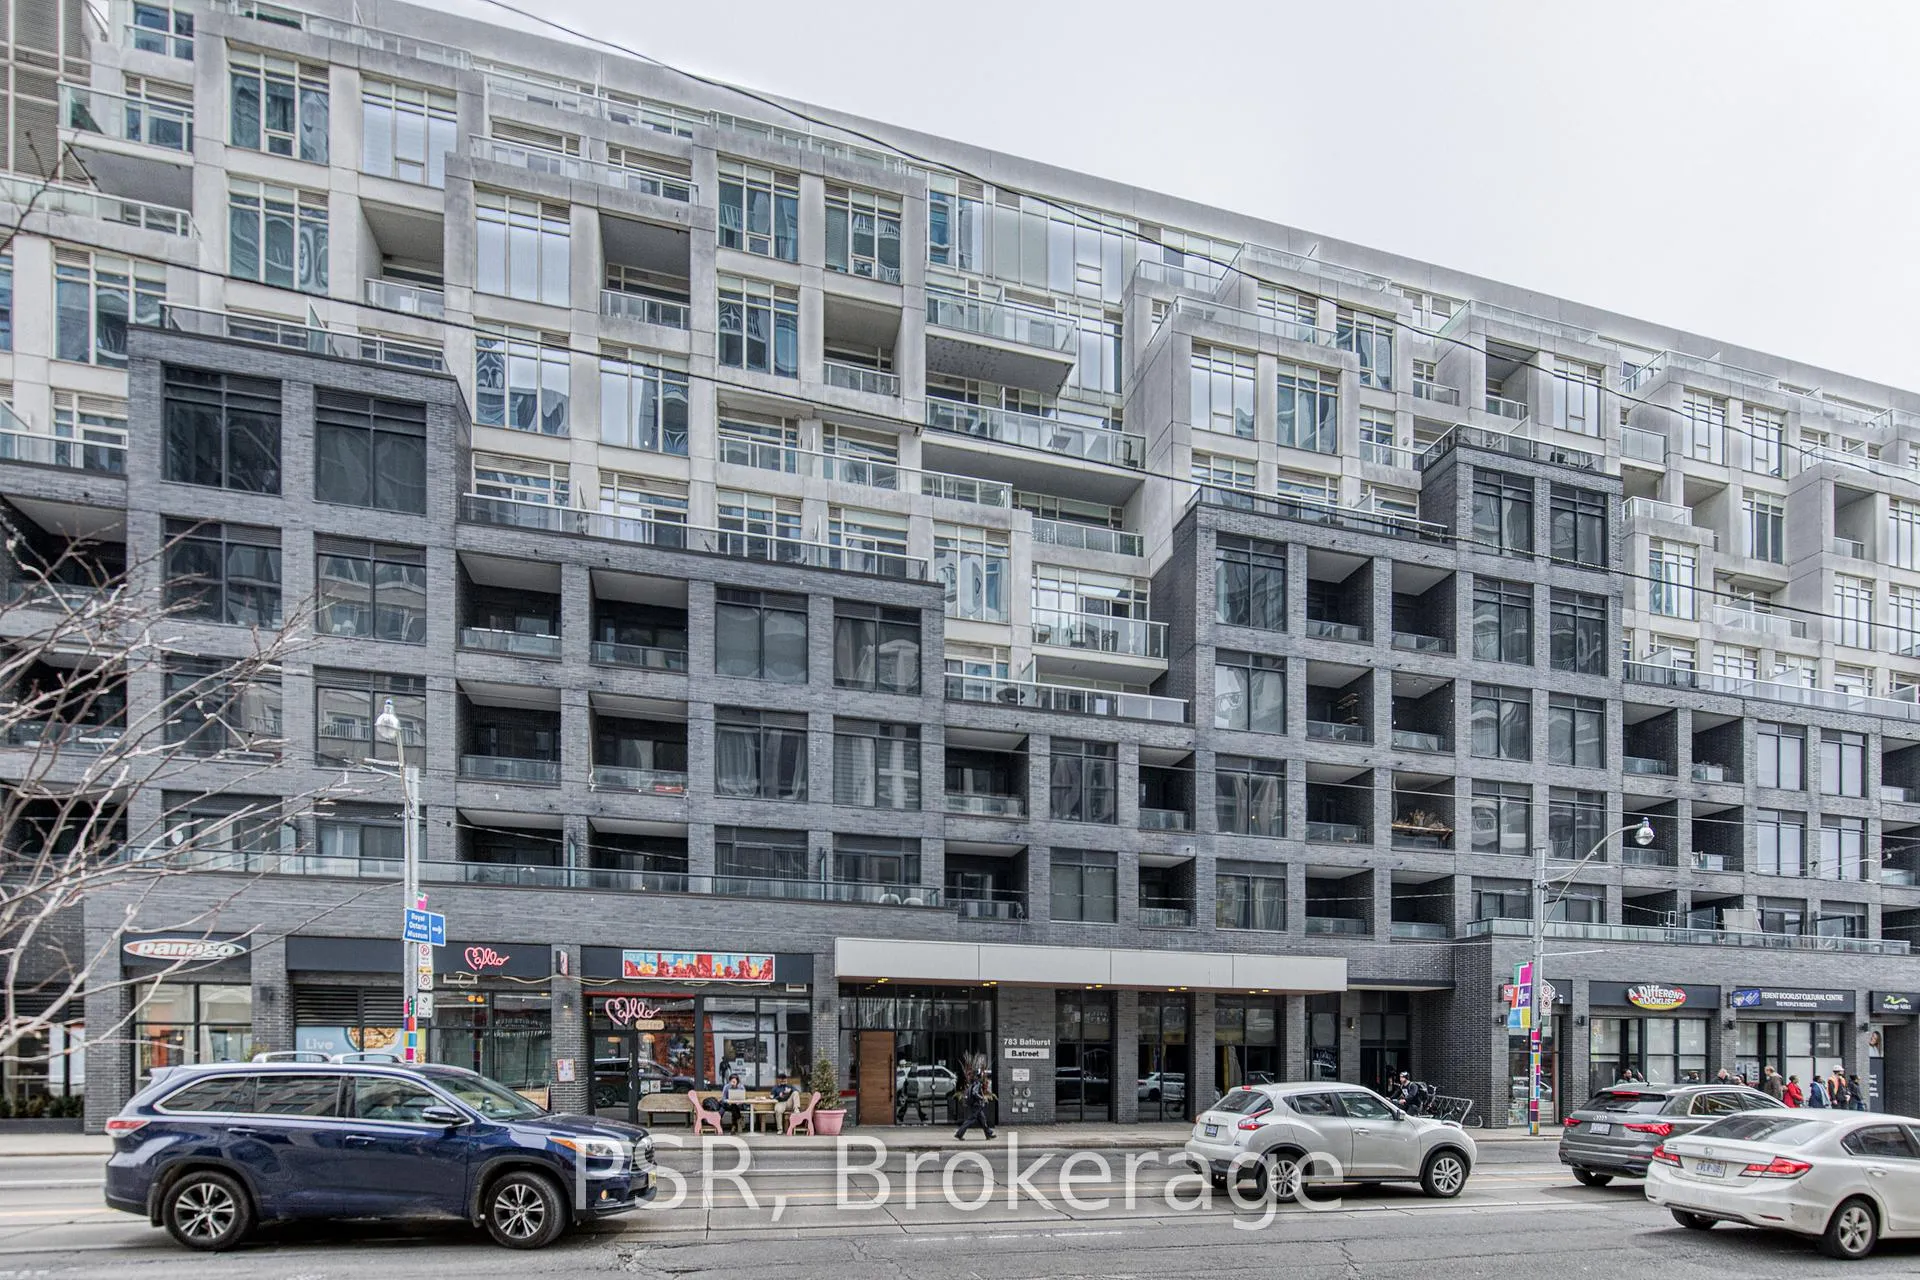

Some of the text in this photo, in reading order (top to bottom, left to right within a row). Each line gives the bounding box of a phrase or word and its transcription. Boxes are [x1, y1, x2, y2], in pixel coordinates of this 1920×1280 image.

[1761, 991, 1780, 999] FERENT
[1004, 1038, 1051, 1046] 783 Bathurst
